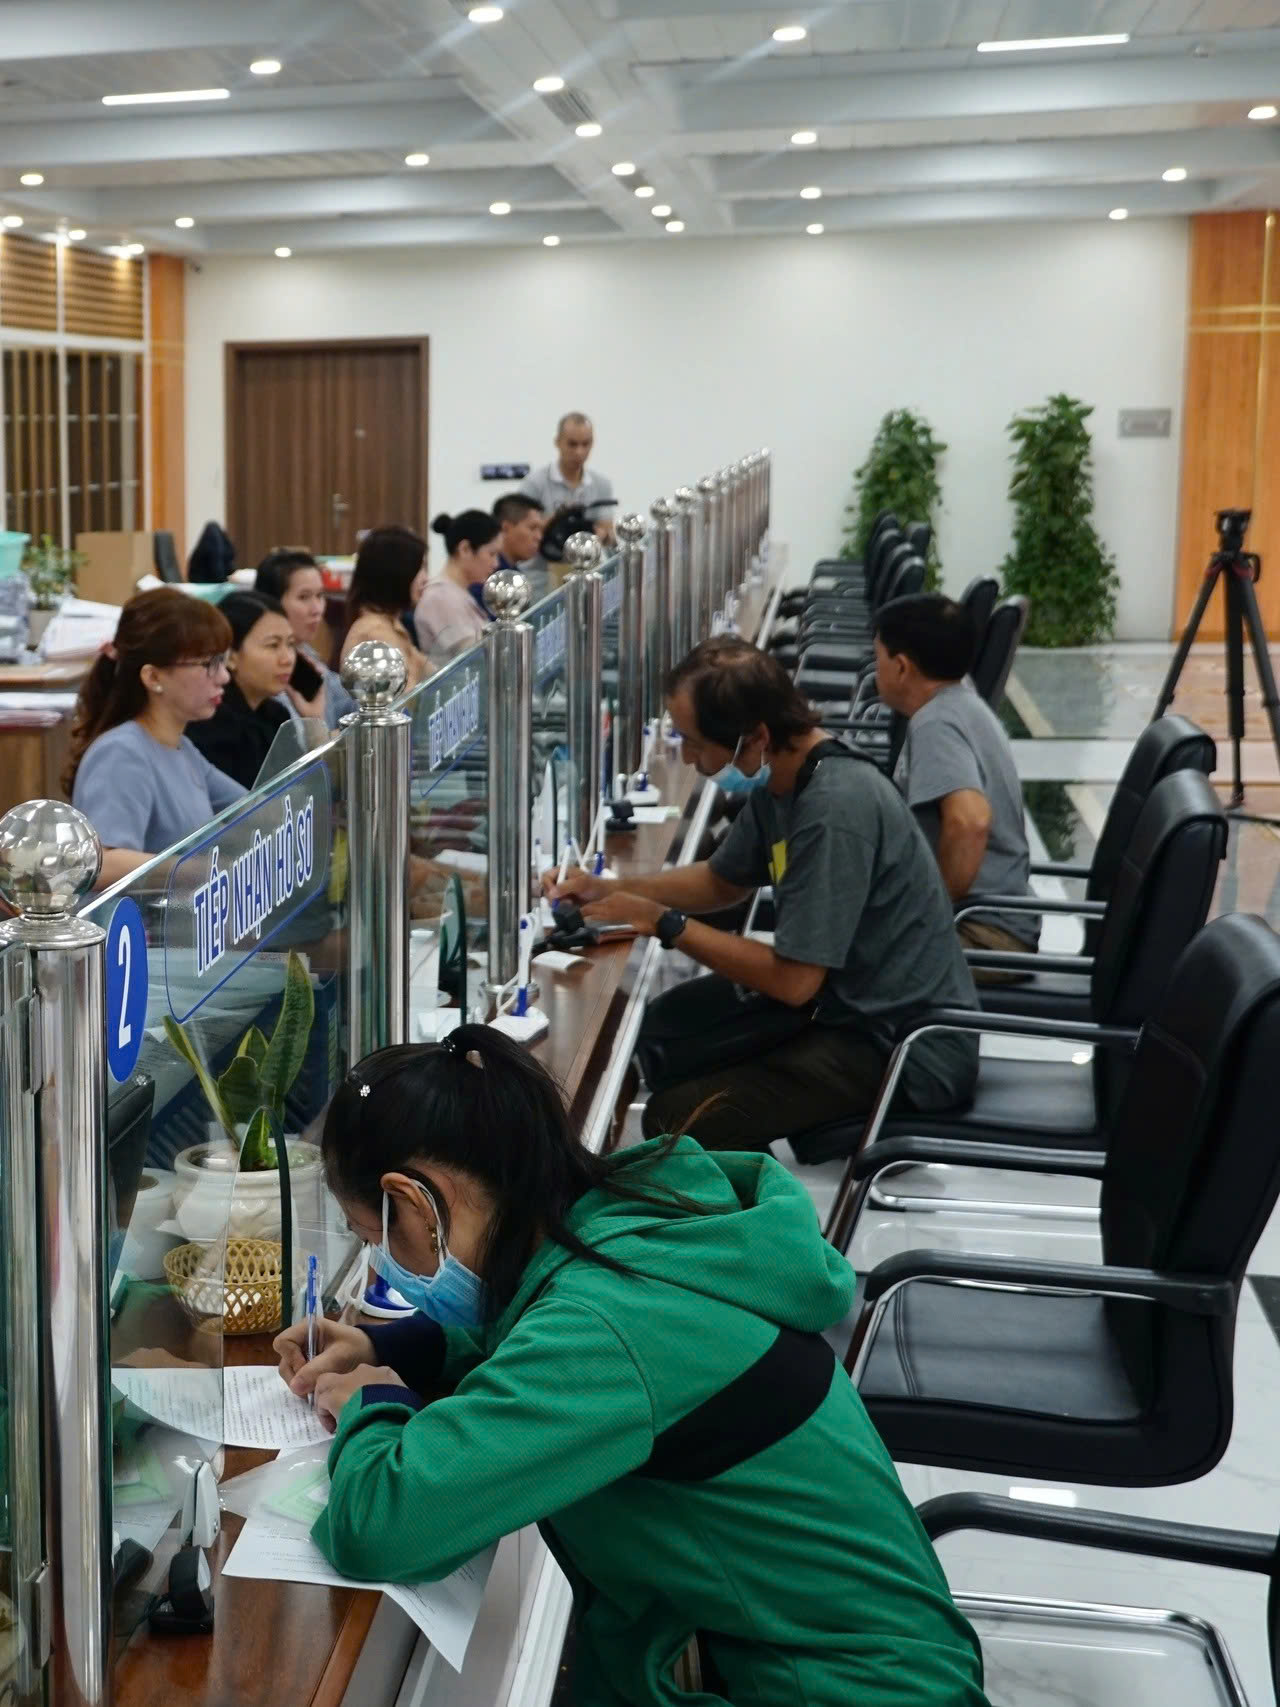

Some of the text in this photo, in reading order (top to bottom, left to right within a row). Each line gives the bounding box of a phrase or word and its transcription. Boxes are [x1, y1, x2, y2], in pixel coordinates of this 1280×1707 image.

[194, 795, 314, 977] TIẾP NHẬN HỒ SƠ
[118, 925, 132, 1049] 2
